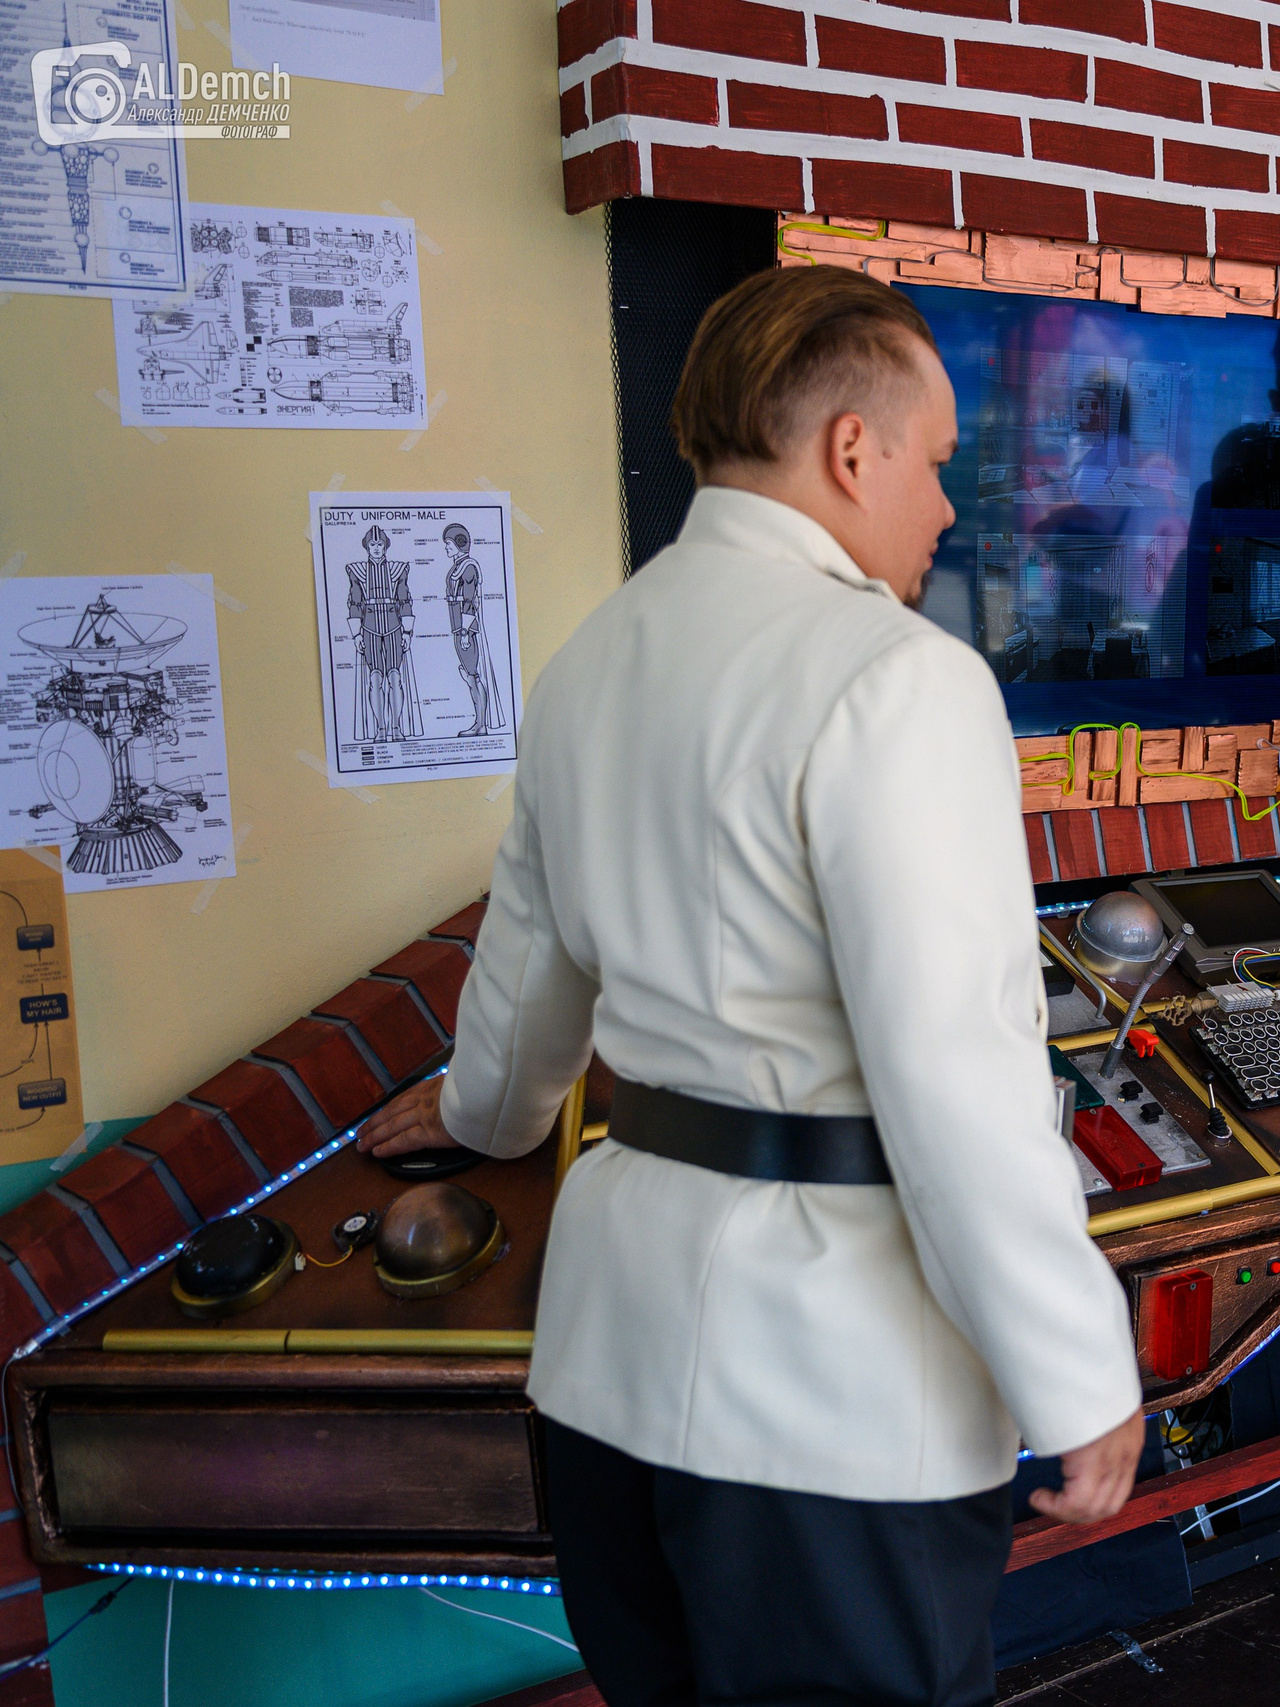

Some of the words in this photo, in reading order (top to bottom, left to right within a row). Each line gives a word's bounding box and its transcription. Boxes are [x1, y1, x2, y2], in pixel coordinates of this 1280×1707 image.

[277, 405, 312, 413] ЭНЕРГИЯ
[324, 512, 353, 521] DUTY
[361, 511, 446, 521] UNIFORM-MALE
[29, 1000, 57, 1008] HOW'S
[42, 1008, 62, 1016] HAIR
[40, 1091, 62, 1099] OUTFIT
